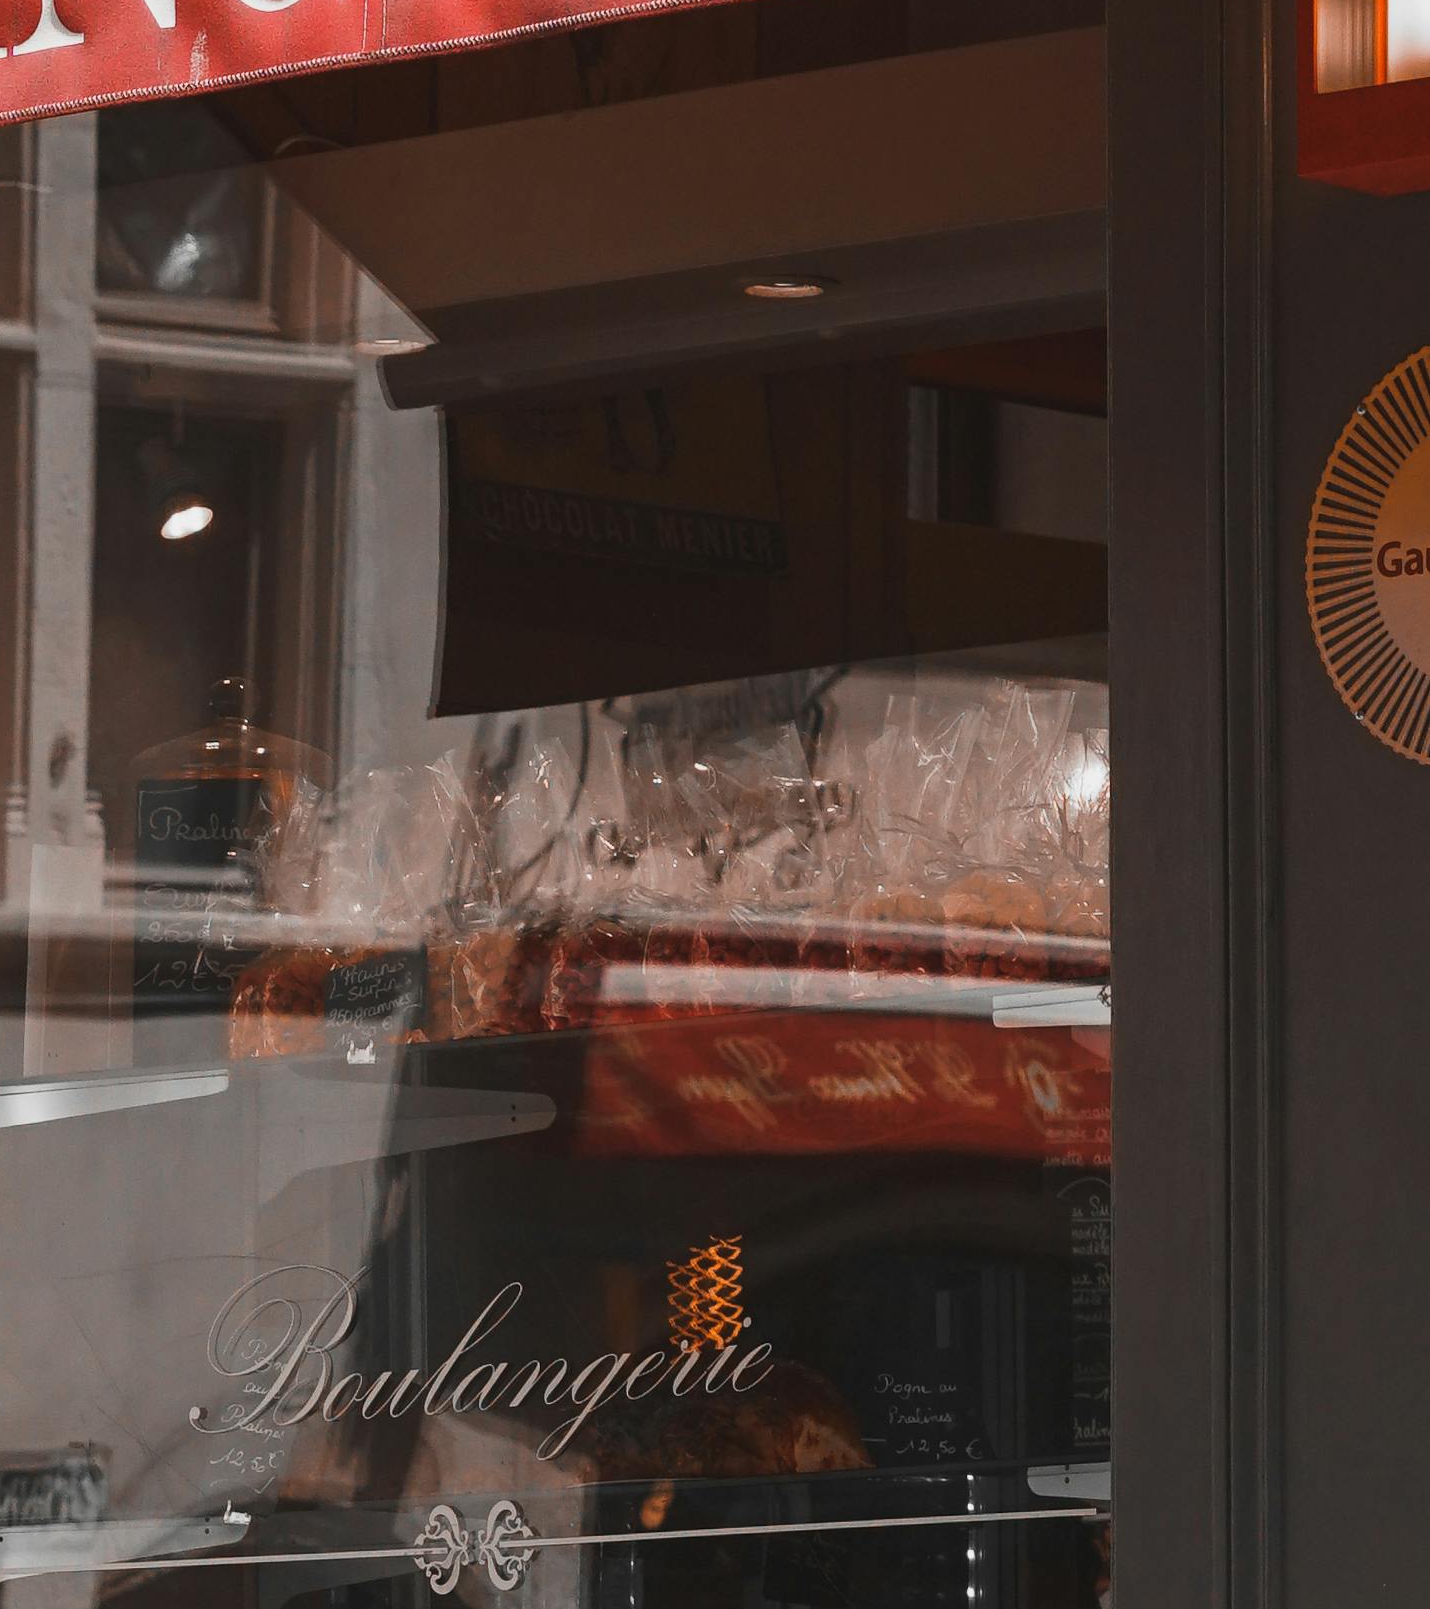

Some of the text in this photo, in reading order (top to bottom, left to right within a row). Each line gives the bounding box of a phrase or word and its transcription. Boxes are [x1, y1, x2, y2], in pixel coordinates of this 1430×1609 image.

[188, 1262, 776, 1461] Boulangerie
[873, 1372, 934, 1400] Pogne
[887, 1404, 954, 1425] Pralines
